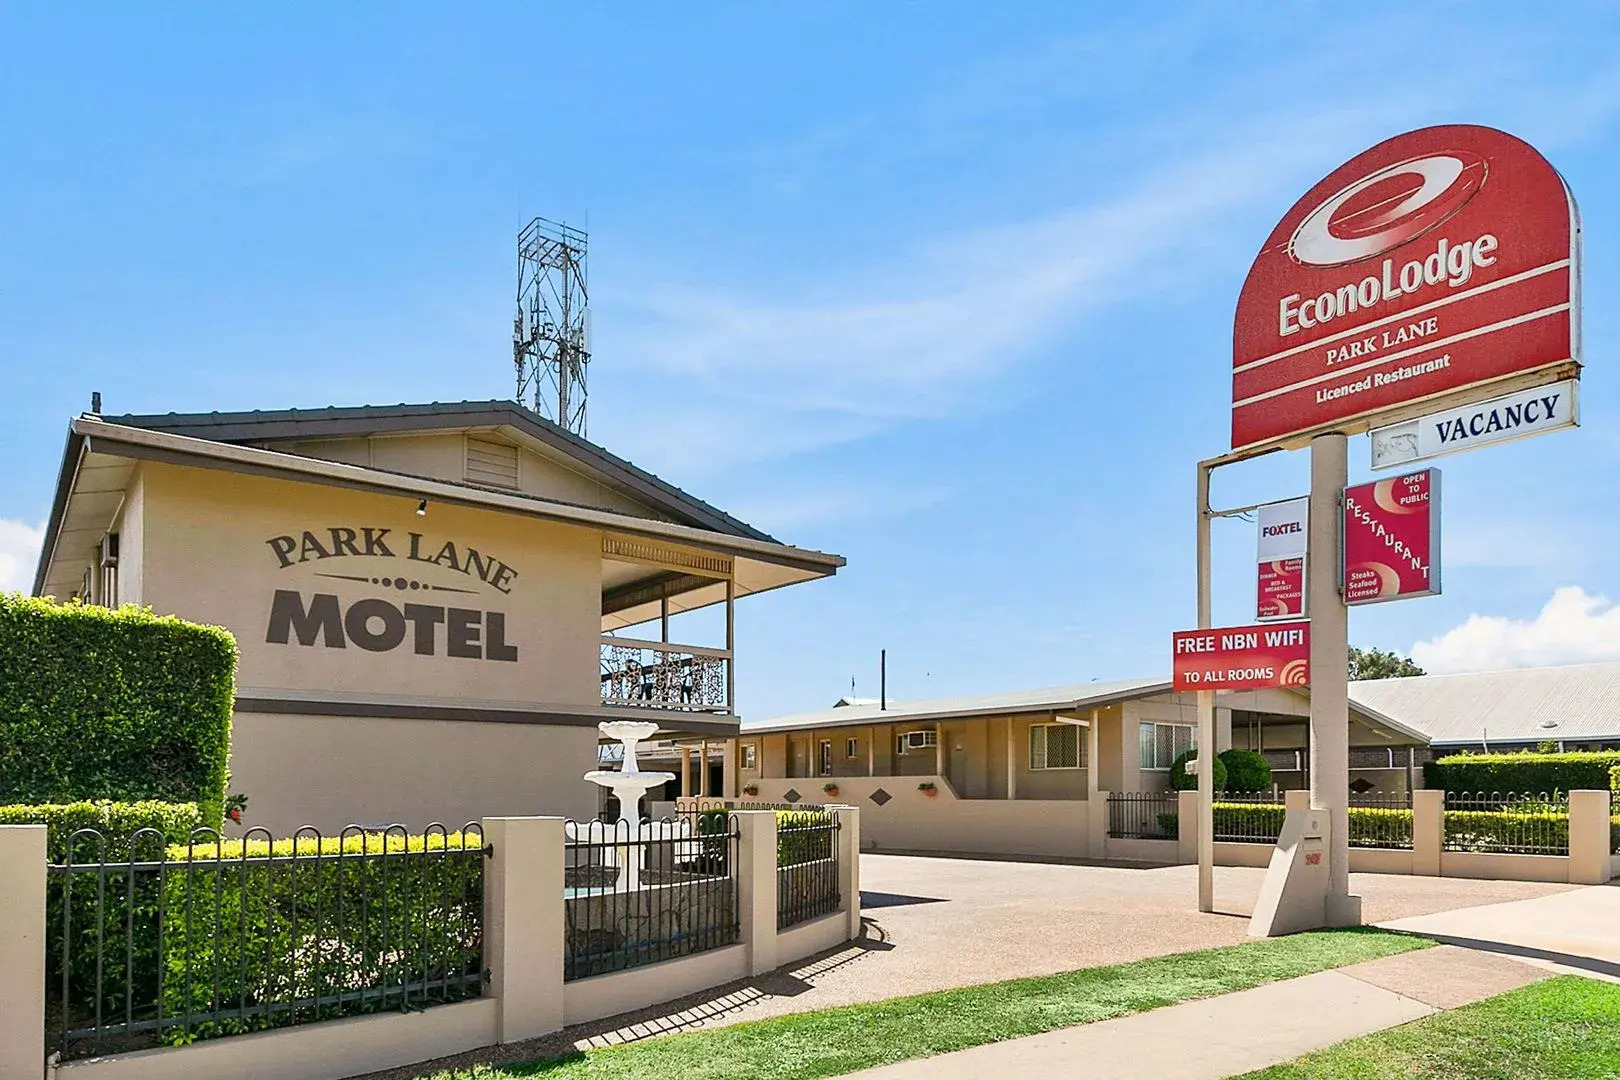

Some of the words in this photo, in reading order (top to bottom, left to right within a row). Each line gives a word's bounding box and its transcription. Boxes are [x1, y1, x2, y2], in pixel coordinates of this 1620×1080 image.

[1279, 233, 1498, 336] EconoLodge
[1326, 335, 1377, 366] PARK
[1382, 317, 1438, 348] LANE
[1316, 376, 1371, 404] Licenced
[1374, 353, 1451, 388] Restaurant
[1436, 394, 1560, 444] VACANCY
[1403, 474, 1425, 485] OPEN
[1409, 485, 1420, 493] TO
[1400, 492, 1429, 505] PUBLIC
[1262, 521, 1303, 538] FOXTEL
[1346, 498, 1429, 578] RESTAURANT
[266, 527, 396, 569] PARK
[407, 532, 518, 595] LANE
[1349, 579, 1377, 590] Seafood
[1351, 571, 1375, 581] Steaks
[1348, 587, 1379, 598] Licensed
[265, 589, 518, 662] MOTEL
[1176, 636, 1215, 654] FREE
[1222, 632, 1258, 651] NBN
[1265, 629, 1304, 647] WIFI
[1184, 671, 1200, 683] TO
[1204, 670, 1226, 682] ALL
[1228, 667, 1274, 681] ROOMS
